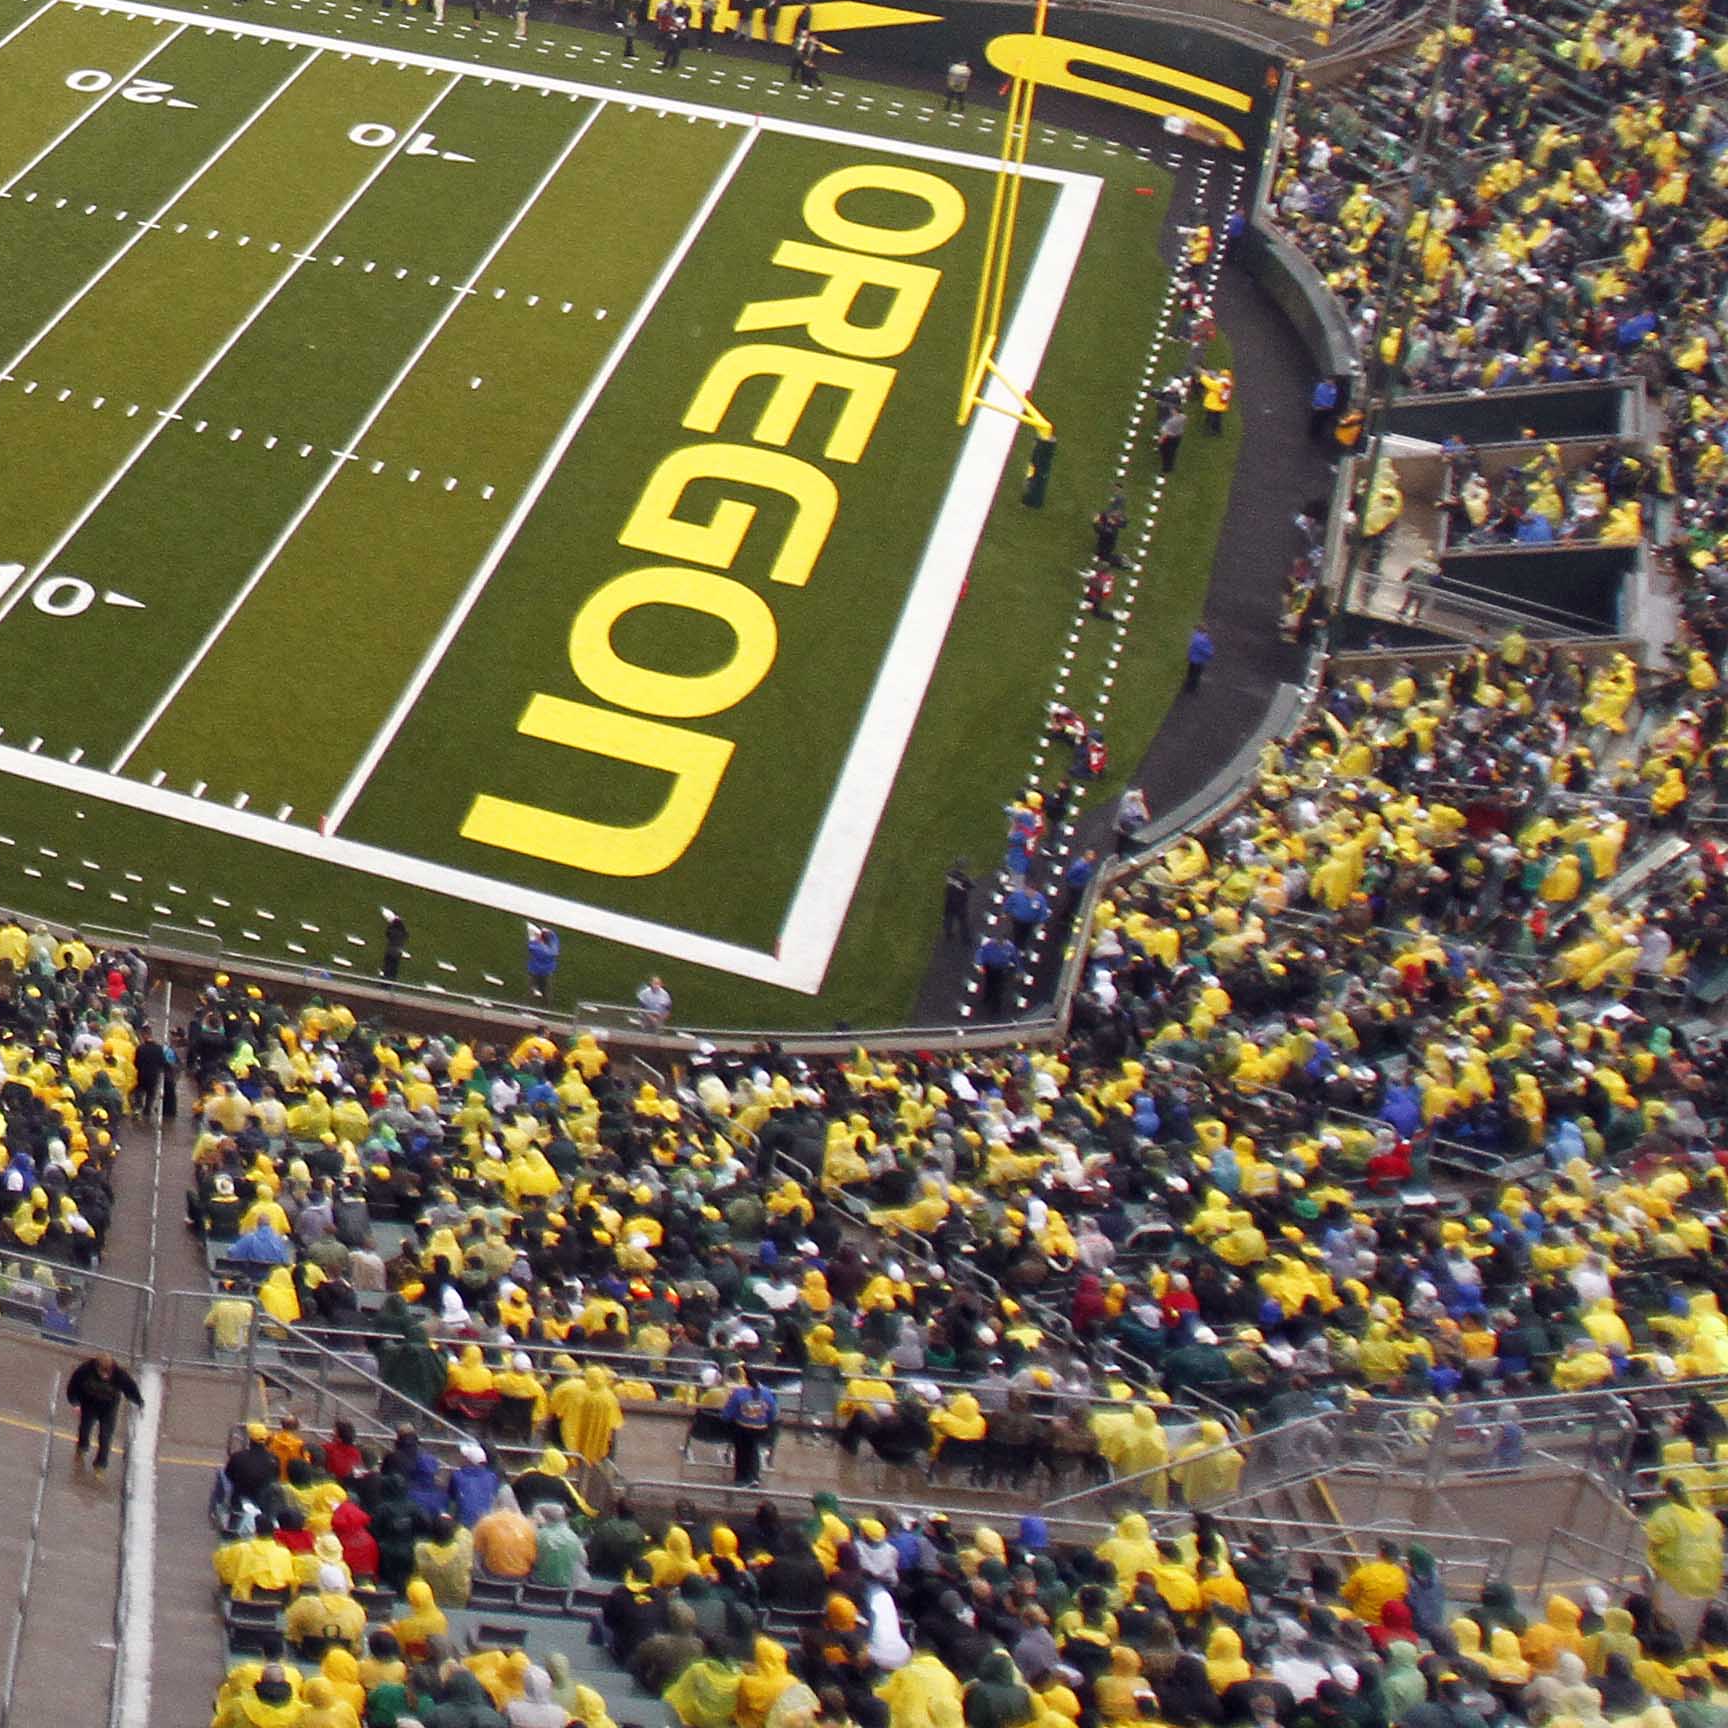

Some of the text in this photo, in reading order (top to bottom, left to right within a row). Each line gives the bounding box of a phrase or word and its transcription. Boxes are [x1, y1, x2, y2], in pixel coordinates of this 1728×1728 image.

[65, 69, 176, 106] 20
[348, 122, 440, 158] 10
[458, 164, 966, 877] OREGON
